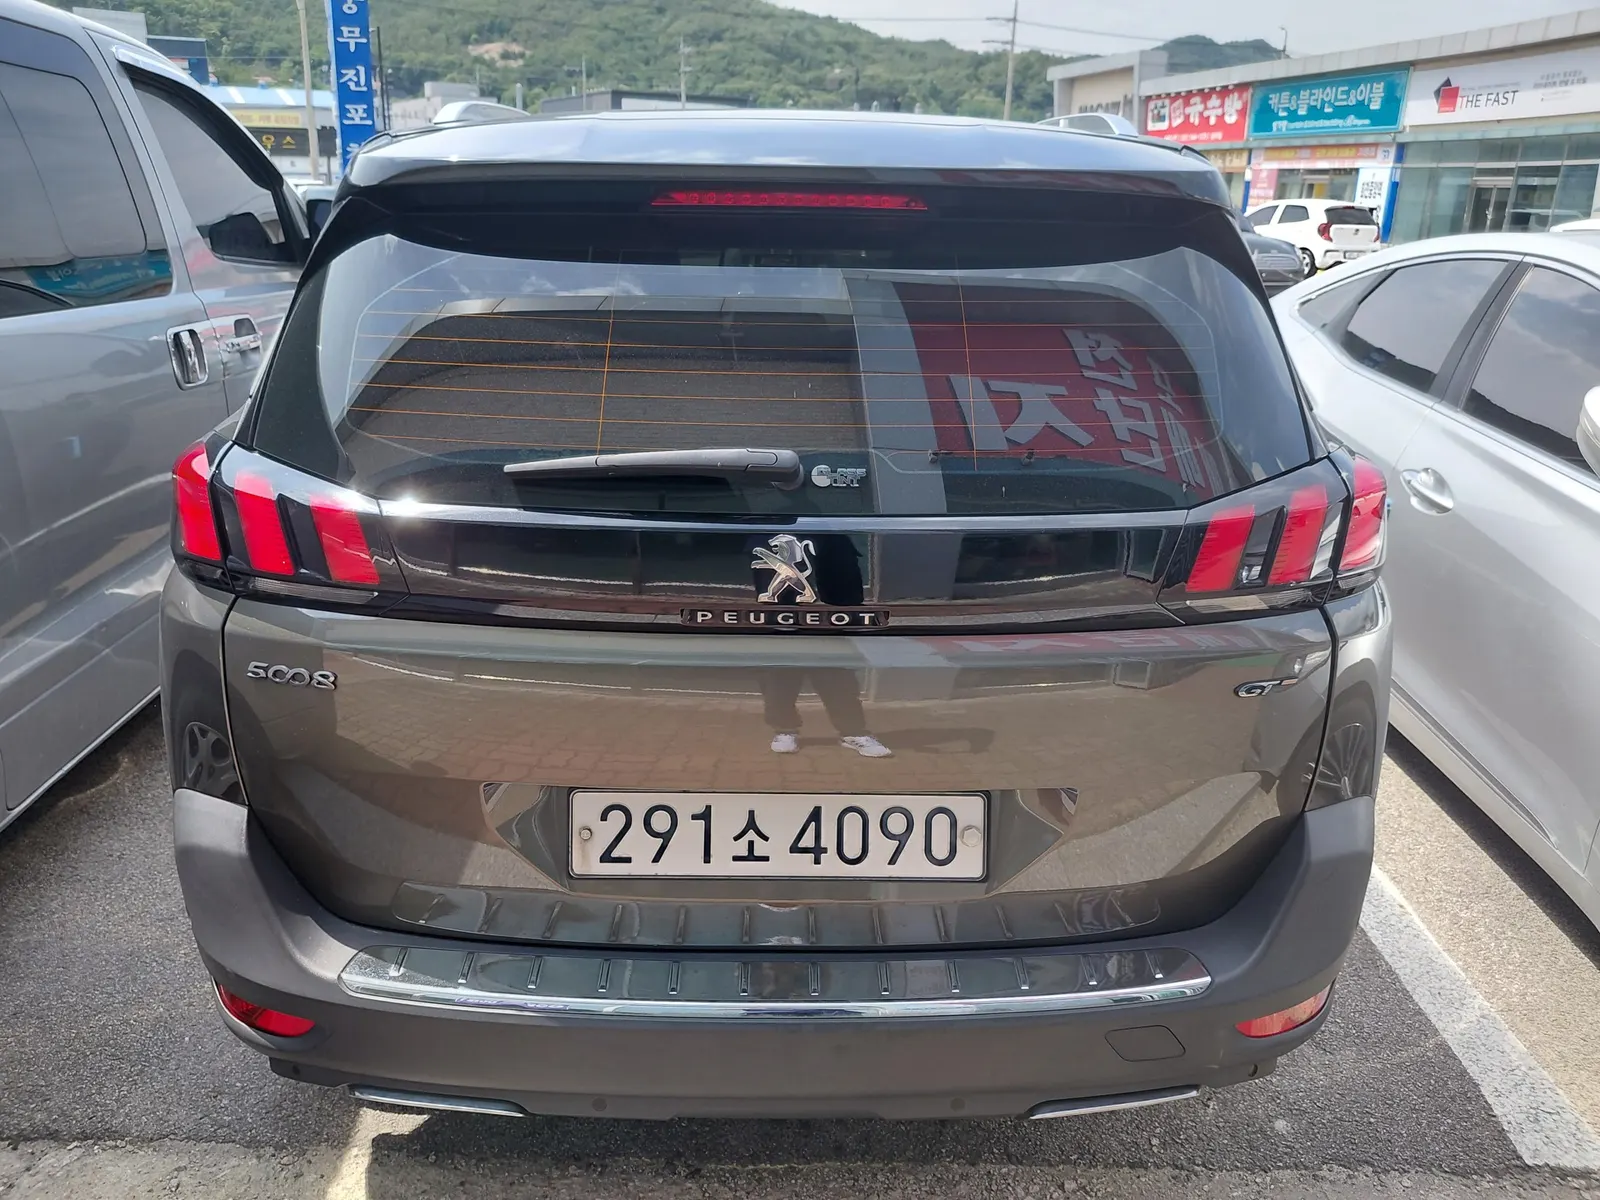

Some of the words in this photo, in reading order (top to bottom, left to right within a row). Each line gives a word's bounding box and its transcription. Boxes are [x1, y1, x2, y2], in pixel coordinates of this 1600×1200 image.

[1459, 93, 1483, 109] THE
[1484, 90, 1519, 107] FAST
[696, 611, 875, 625] PEUGEOT
[246, 661, 336, 690] 5008
[1237, 680, 1281, 697] GT
[788, 805, 958, 867] 4090
